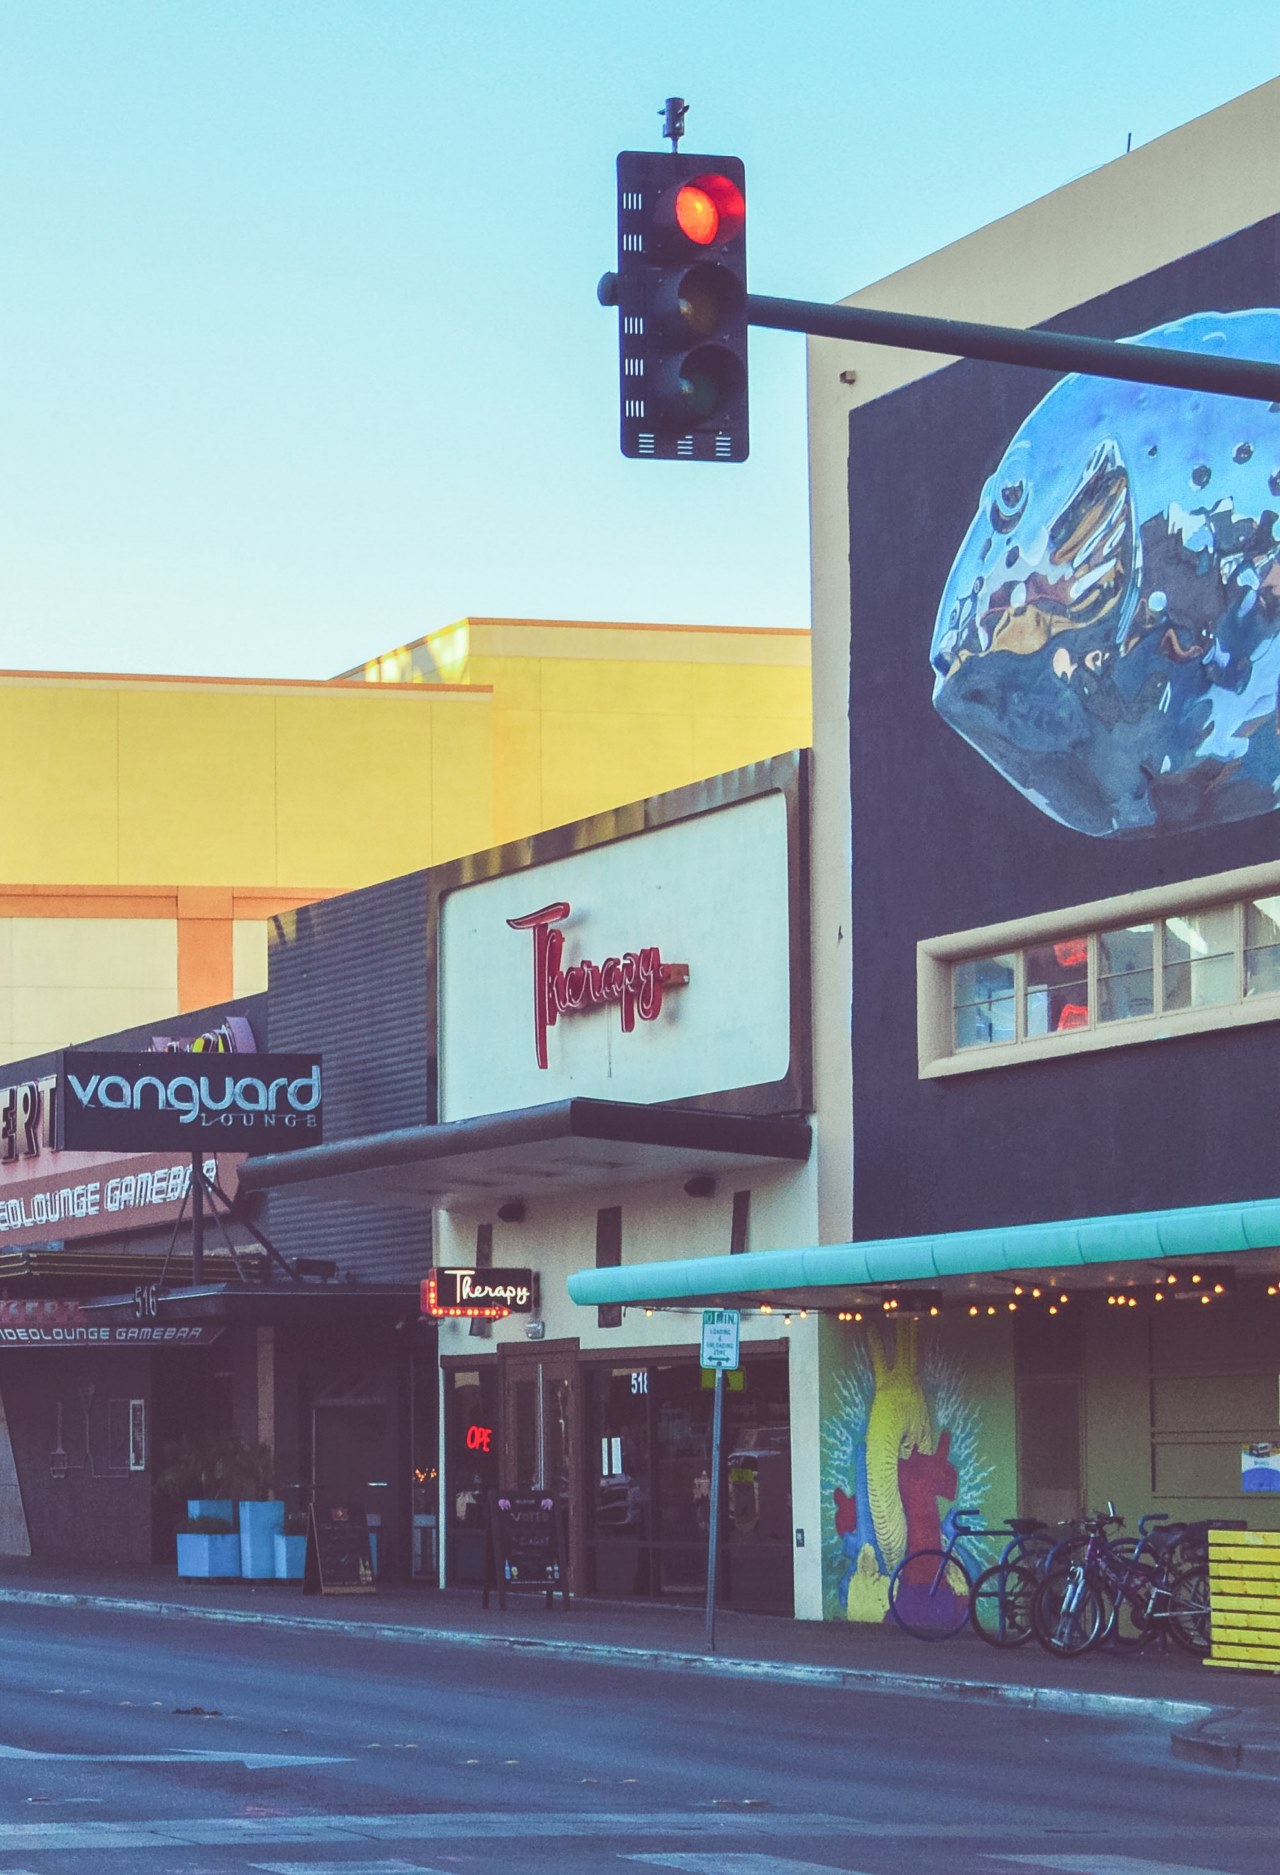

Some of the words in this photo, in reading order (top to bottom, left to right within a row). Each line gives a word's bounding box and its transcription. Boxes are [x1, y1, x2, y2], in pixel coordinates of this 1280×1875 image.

[506, 902, 664, 1069] Therapy
[67, 1064, 322, 1125] vanguard
[201, 1112, 318, 1128] LOUNGE
[103, 1158, 219, 1211] GAMEBAR
[135, 1284, 158, 1318] 516
[443, 1270, 530, 1304] Therapy
[115, 1326, 203, 1341] GAMEBAR
[465, 1424, 493, 1453] OPE
